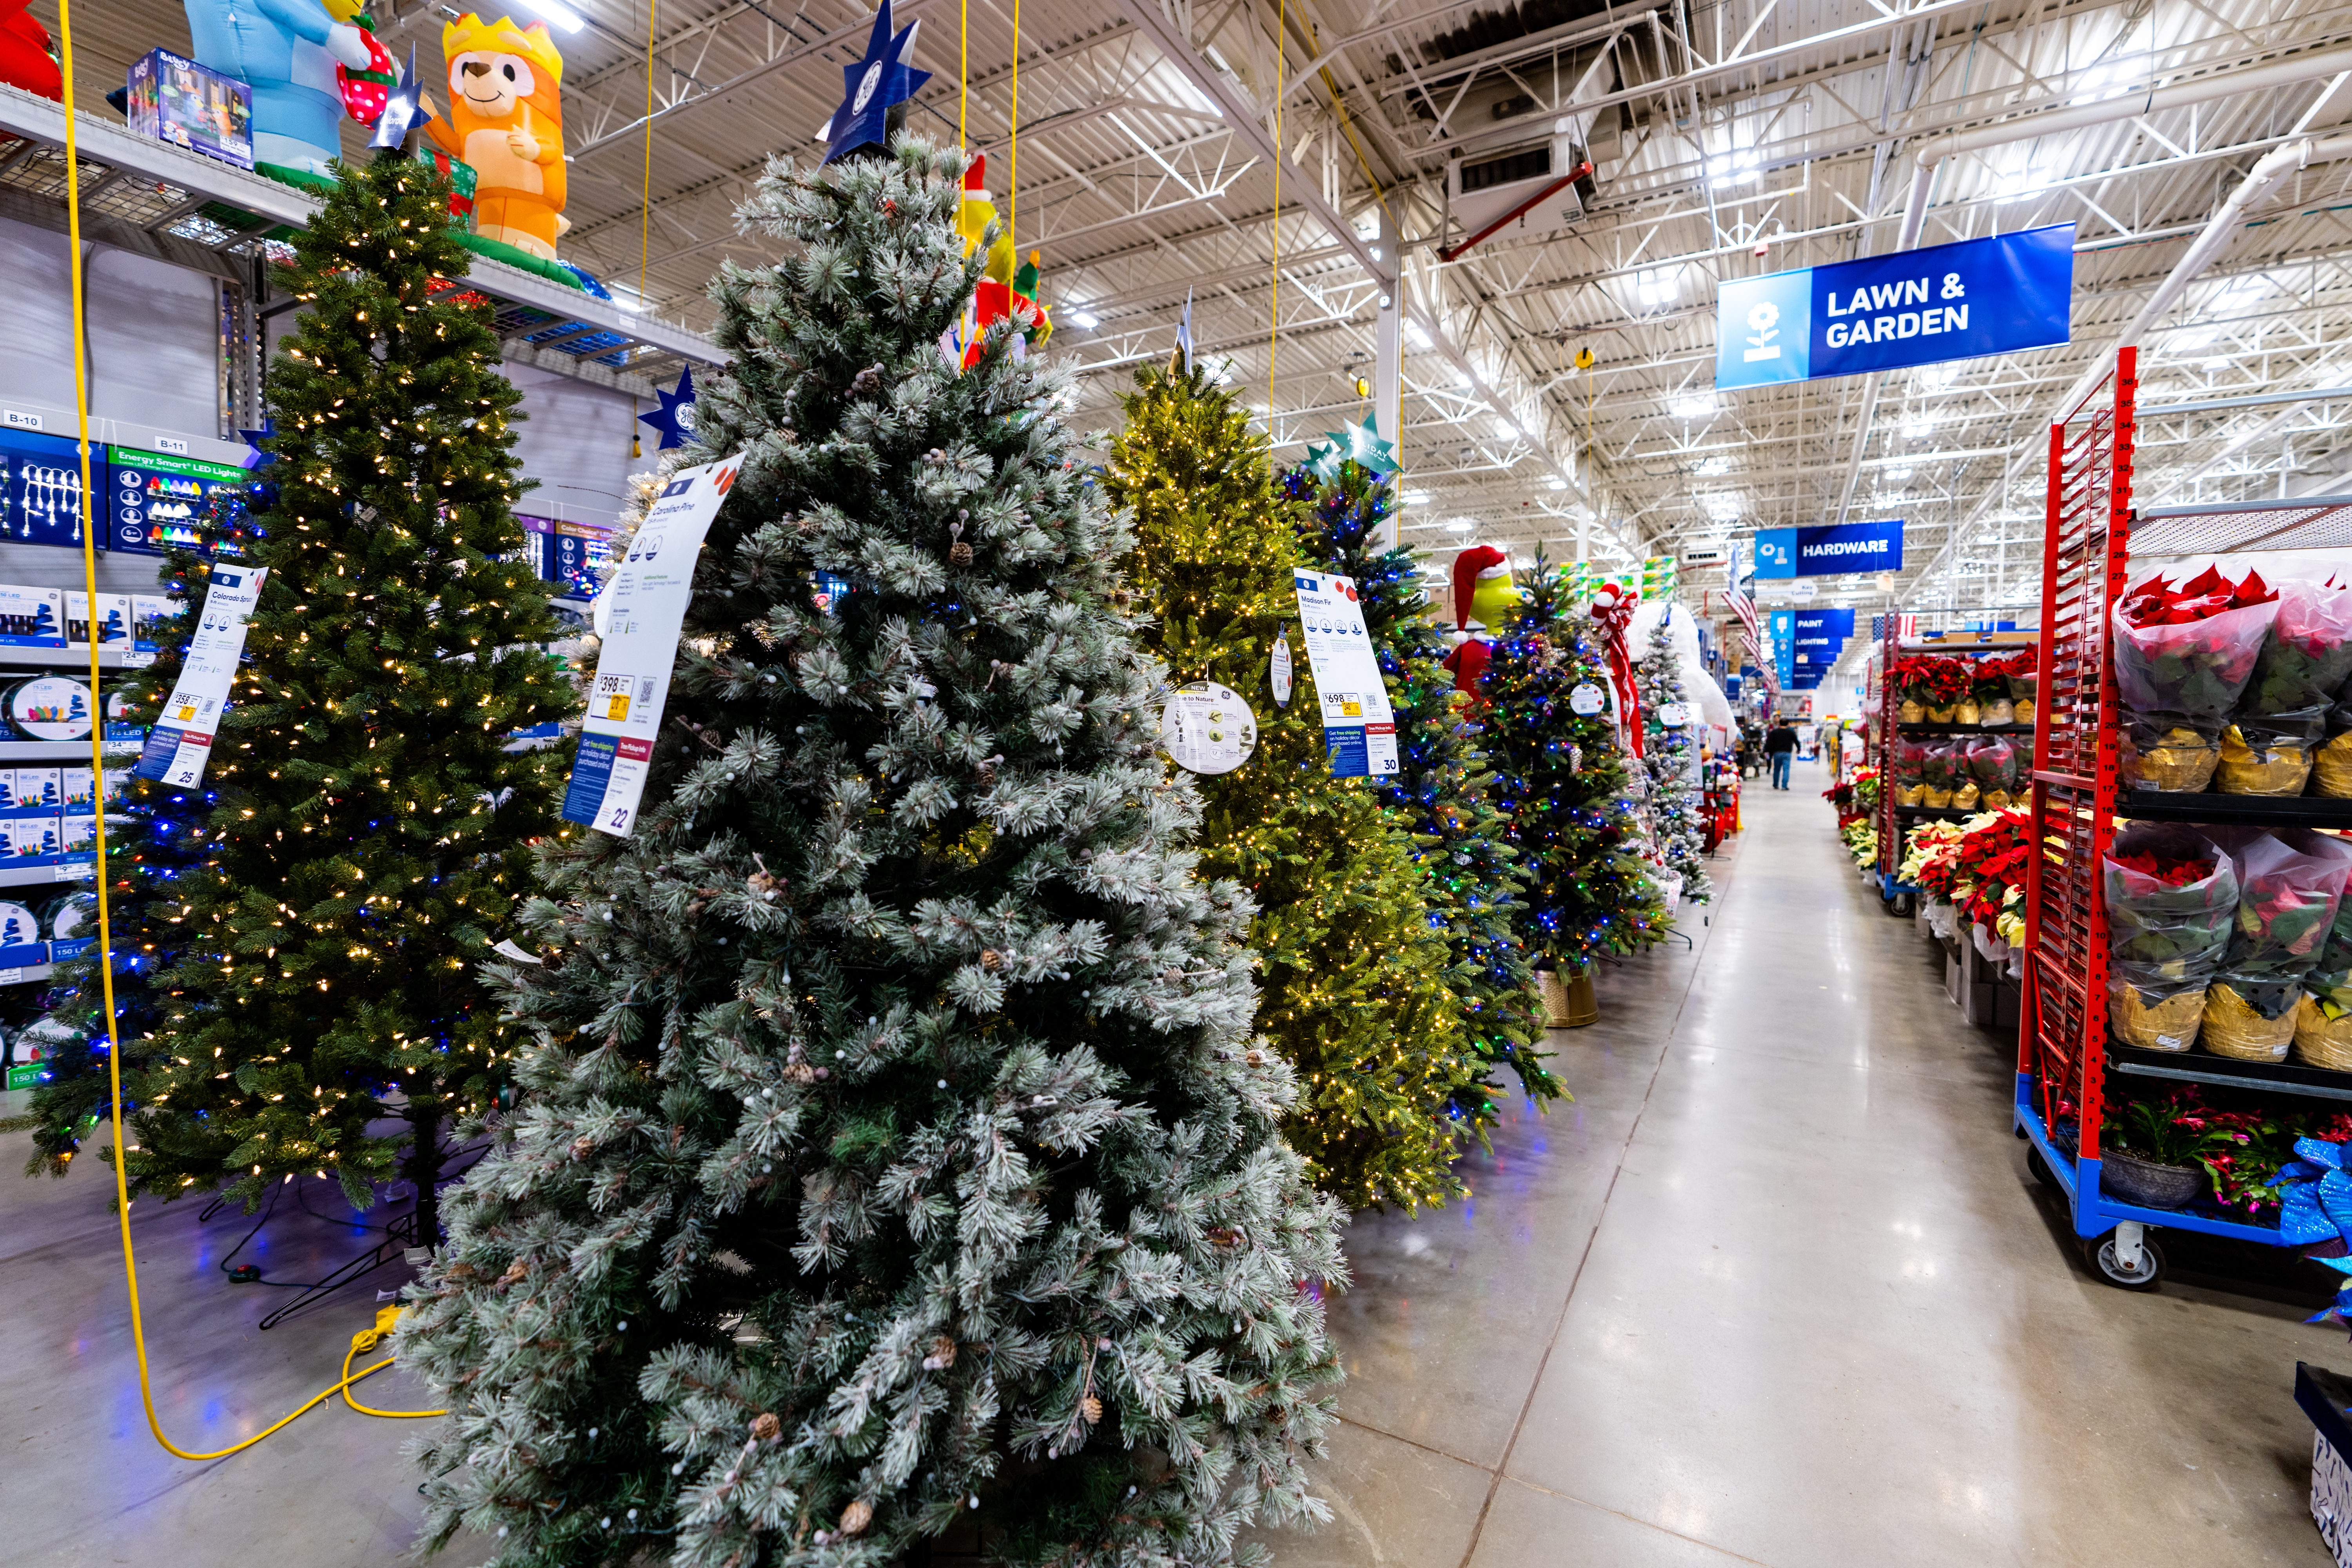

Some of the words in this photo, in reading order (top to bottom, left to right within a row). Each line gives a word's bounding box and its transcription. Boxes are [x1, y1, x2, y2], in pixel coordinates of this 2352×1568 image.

[135, 58, 149, 78] BLUEY
[160, 51, 190, 71] BLUEY
[1828, 277, 1929, 318] LAWN
[1940, 272, 1965, 299] &
[1826, 303, 1969, 348] GARDEN
[10, 414, 37, 426] B-10
[161, 440, 183, 450] B-11
[1347, 434, 1387, 458] HLIDAY
[119, 452, 154, 465] Energy
[193, 464, 211, 473] LED
[213, 468, 241, 478] Lights
[652, 504, 679, 516] Carolina
[679, 502, 695, 512] Pine
[1803, 539, 1888, 557] HARDWARE
[212, 591, 240, 602] Colorado
[240, 595, 253, 604] Spruce
[1301, 595, 1324, 605] Madison
[1798, 619, 1823, 628] PAINT
[600, 676, 619, 693] $398
[176, 693, 190, 705] $358
[1325, 694, 1345, 703] $698
[1384, 759, 1396, 770] 30
[178, 771, 194, 783] 25
[610, 808, 628, 829] 22
